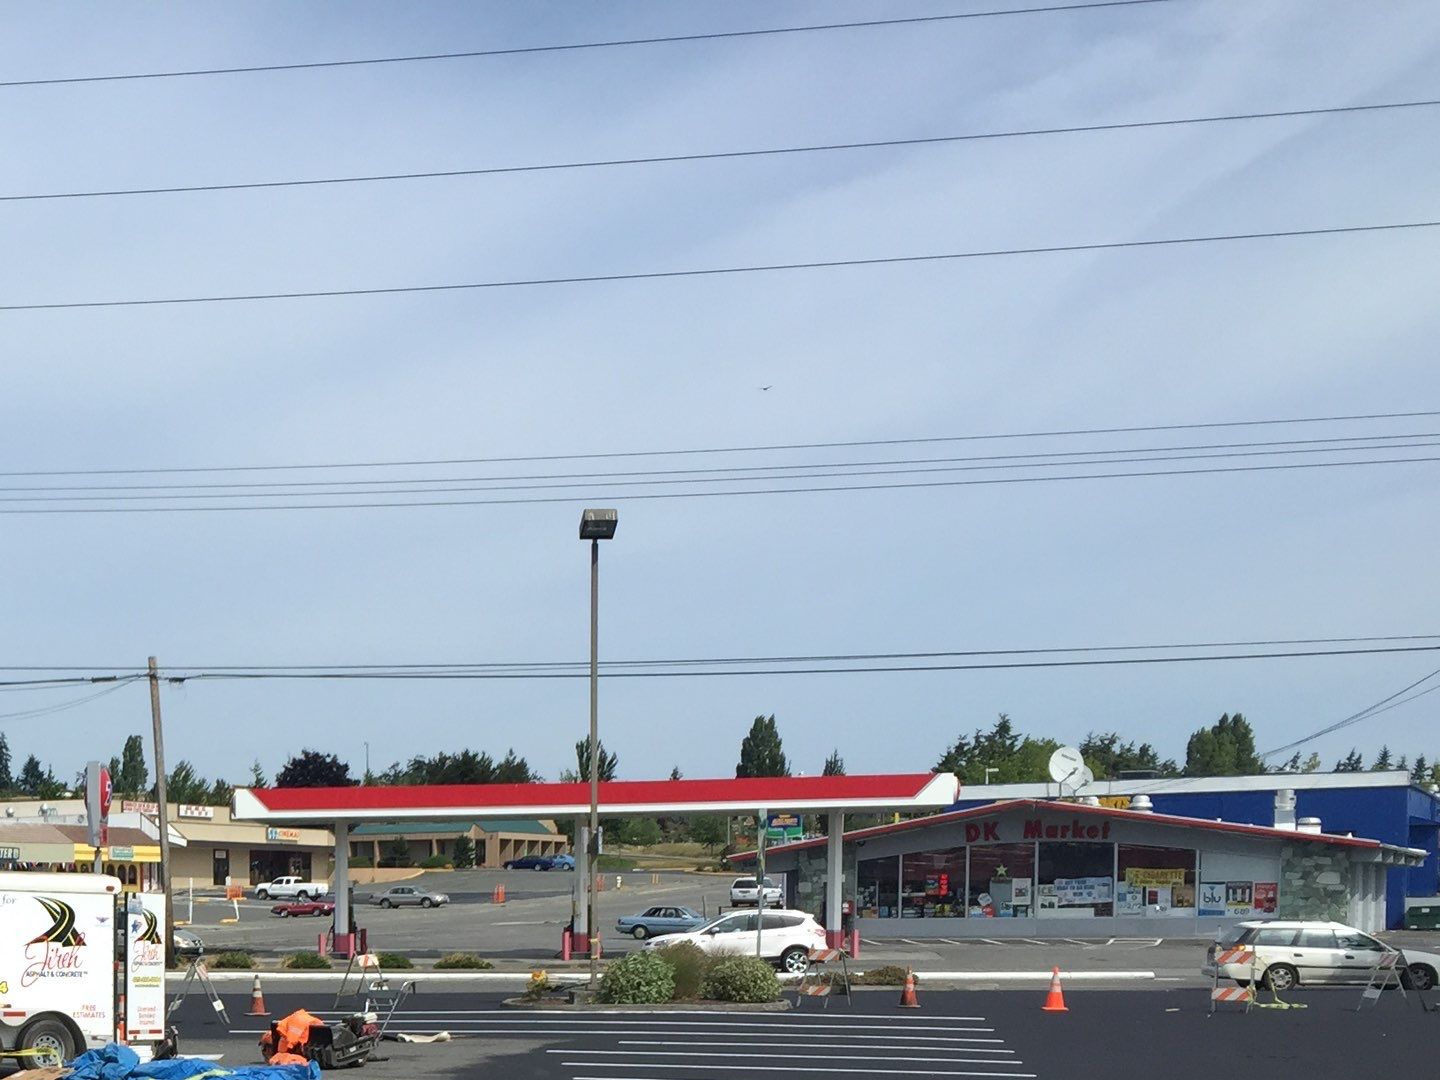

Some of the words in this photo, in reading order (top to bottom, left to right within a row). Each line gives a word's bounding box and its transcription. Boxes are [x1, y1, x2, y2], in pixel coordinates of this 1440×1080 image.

[965, 821, 1000, 842] DK
[1023, 819, 1111, 840] Market
[0, 893, 17, 907] for
[1203, 891, 1221, 903] blu
[72, 1011, 106, 1019] ESTIMATES
